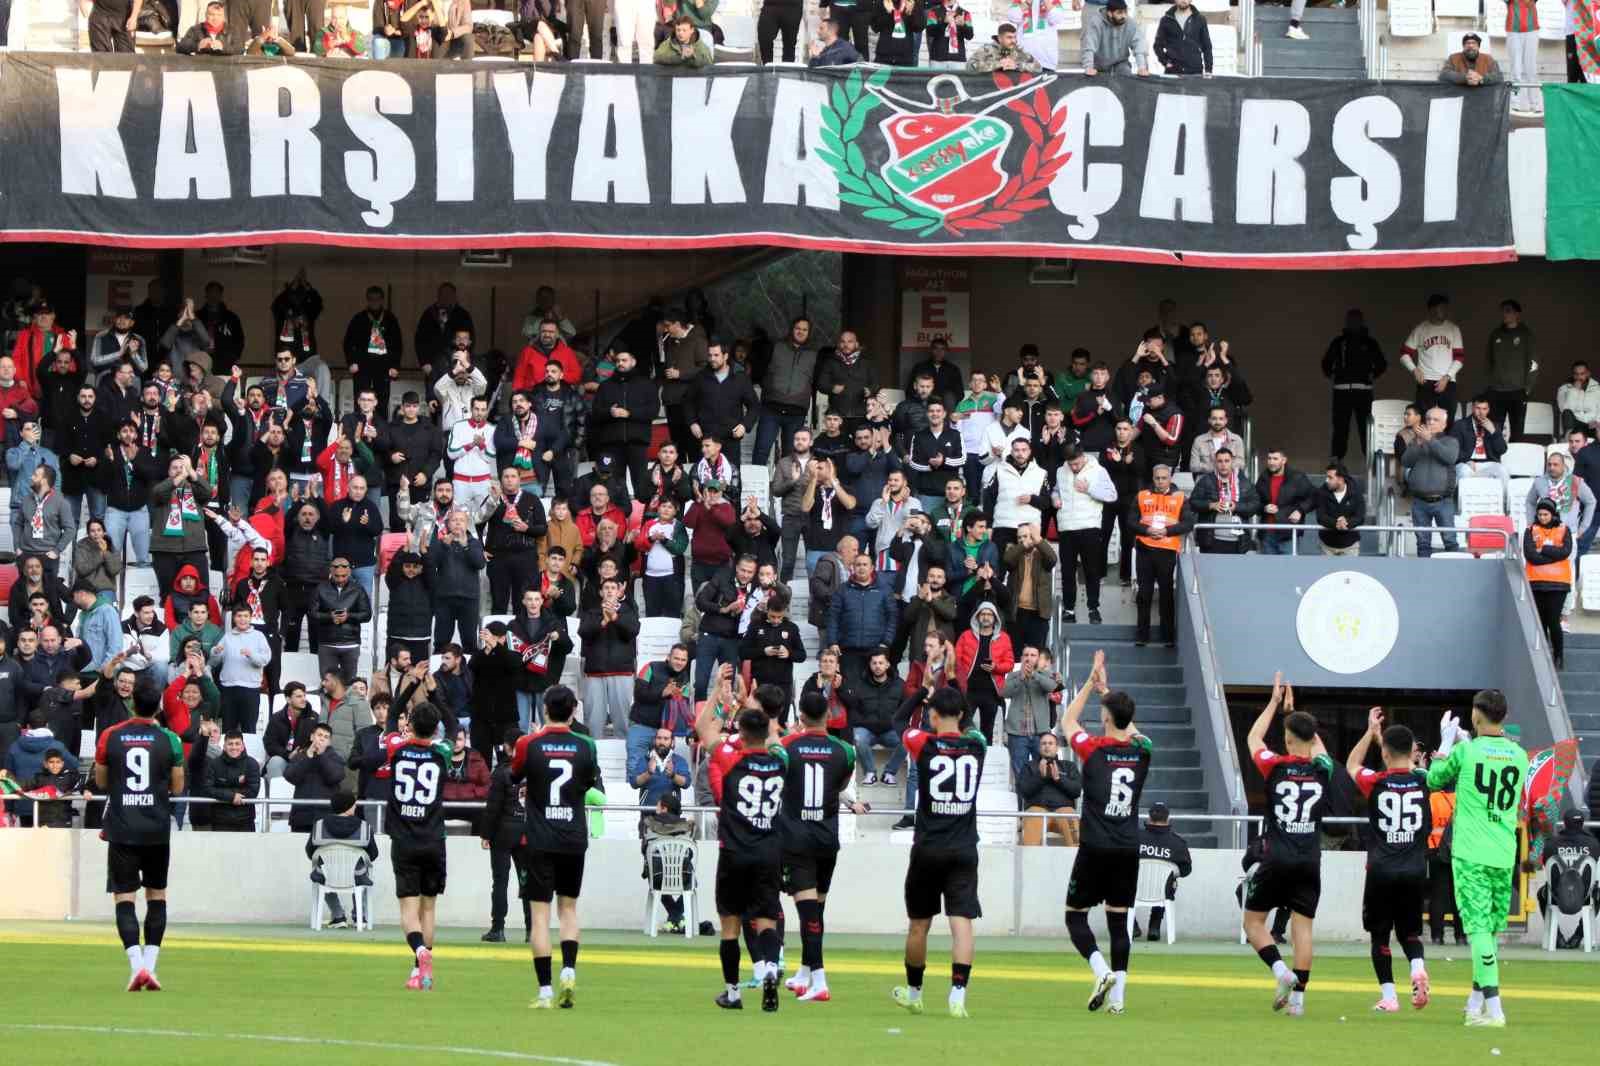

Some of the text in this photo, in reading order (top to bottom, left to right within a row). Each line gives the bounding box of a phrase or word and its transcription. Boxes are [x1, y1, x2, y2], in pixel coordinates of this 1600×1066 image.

[56, 67, 1465, 250] KARŞIYAKA ÇARŞI
[921, 296, 947, 328] E
[126, 747, 150, 792] 9
[394, 760, 440, 805] 59
[548, 759, 573, 806] 7
[804, 762, 825, 808] 11
[929, 754, 978, 802] 20
[1110, 767, 1135, 806] 6
[1474, 762, 1520, 811] 48
[400, 804, 425, 817] ADEM
[737, 775, 784, 817] 93
[1274, 781, 1323, 823] 37
[1378, 791, 1424, 832] 95
